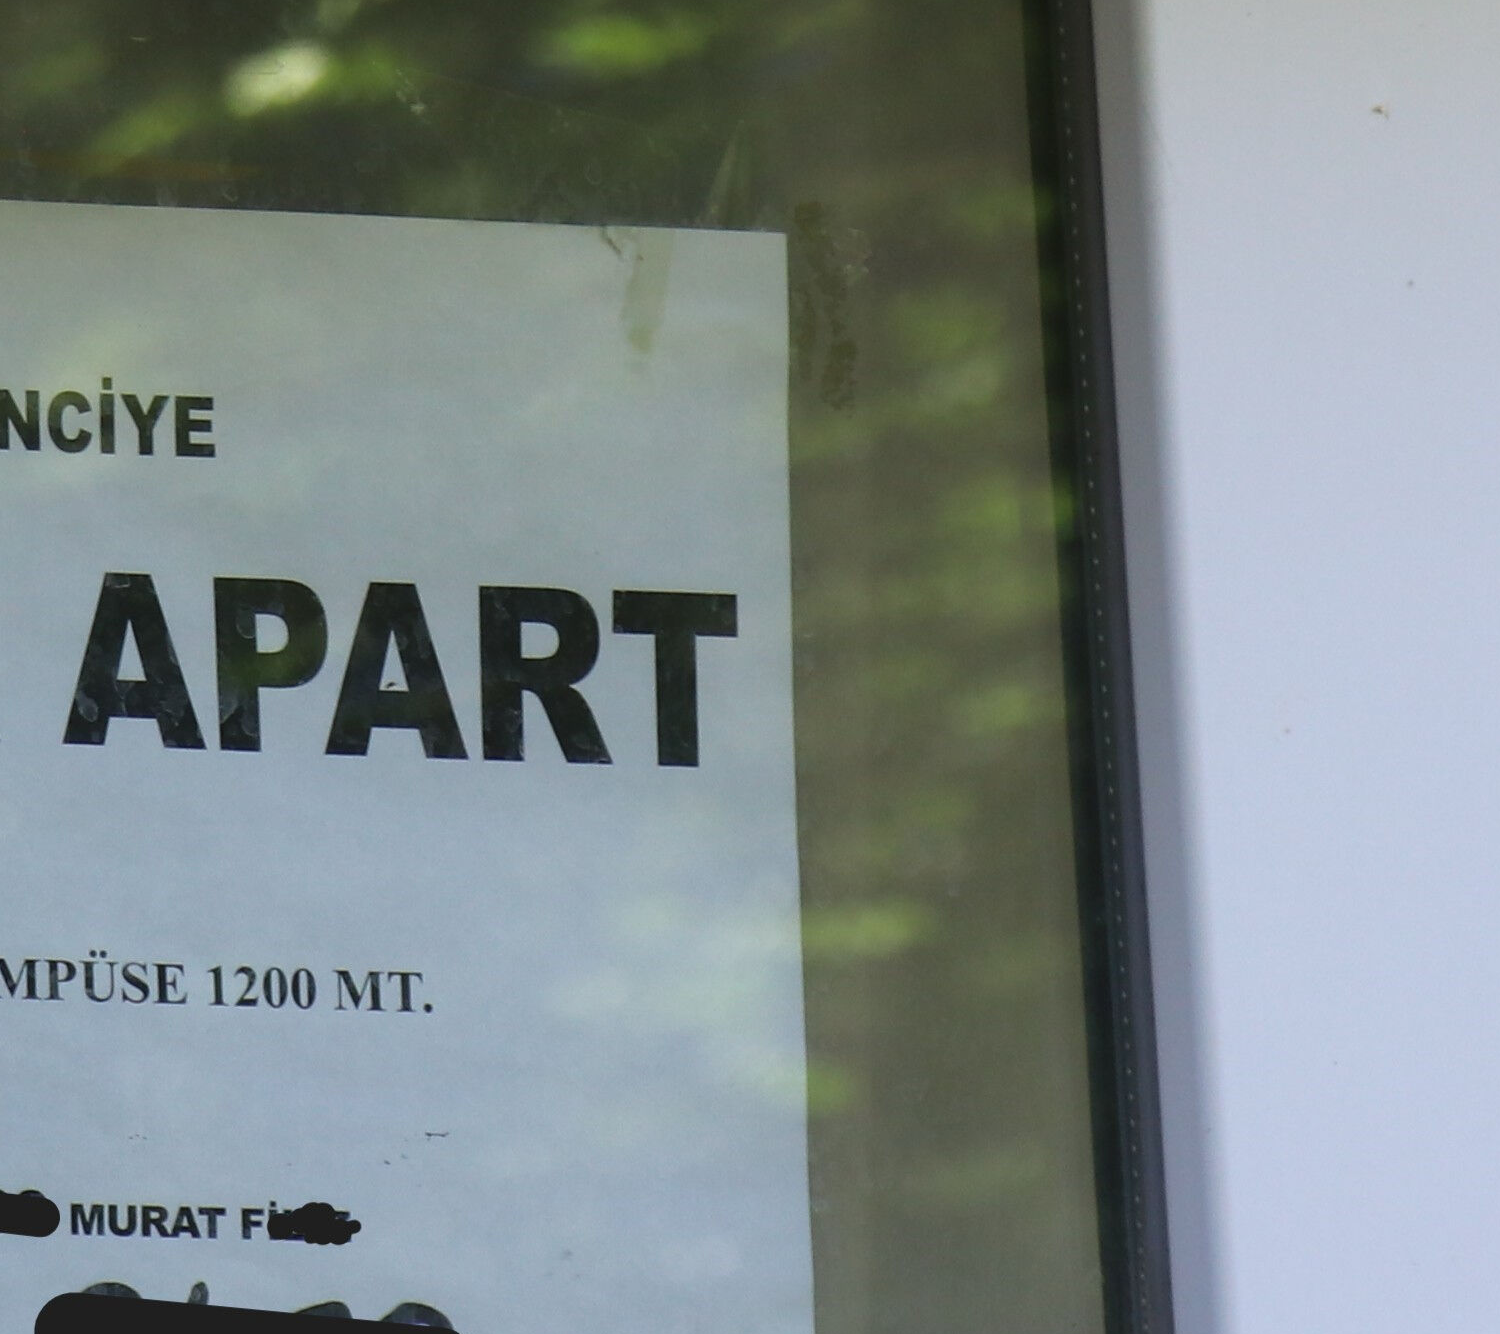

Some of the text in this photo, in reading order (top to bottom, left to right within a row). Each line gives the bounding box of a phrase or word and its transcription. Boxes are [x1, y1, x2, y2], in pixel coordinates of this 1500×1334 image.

[62, 572, 739, 767] APART
[207, 965, 317, 1010] 1200
[333, 969, 433, 1014] MT.
[70, 1202, 227, 1240] MURAT
